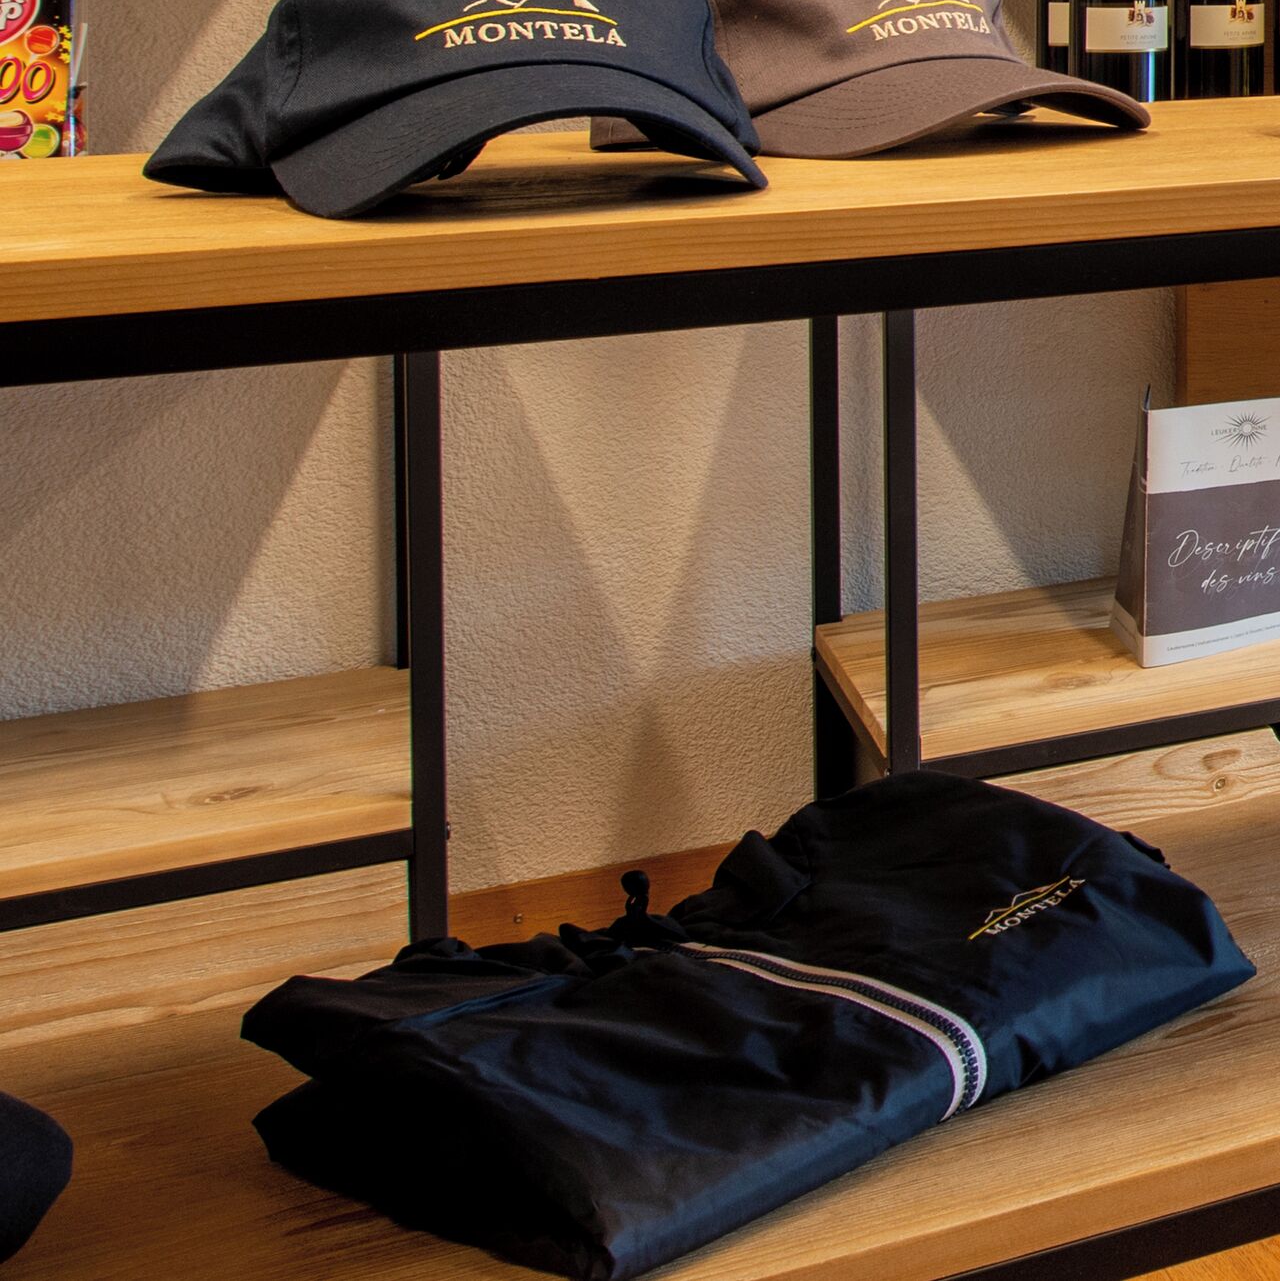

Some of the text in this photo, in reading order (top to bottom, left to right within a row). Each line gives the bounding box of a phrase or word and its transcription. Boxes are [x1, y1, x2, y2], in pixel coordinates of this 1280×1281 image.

[443, 21, 627, 48] MONTELA
[869, 11, 992, 41] MONTELA
[1201, 566, 1278, 593] des vins
[984, 878, 1086, 935] MONTELA
